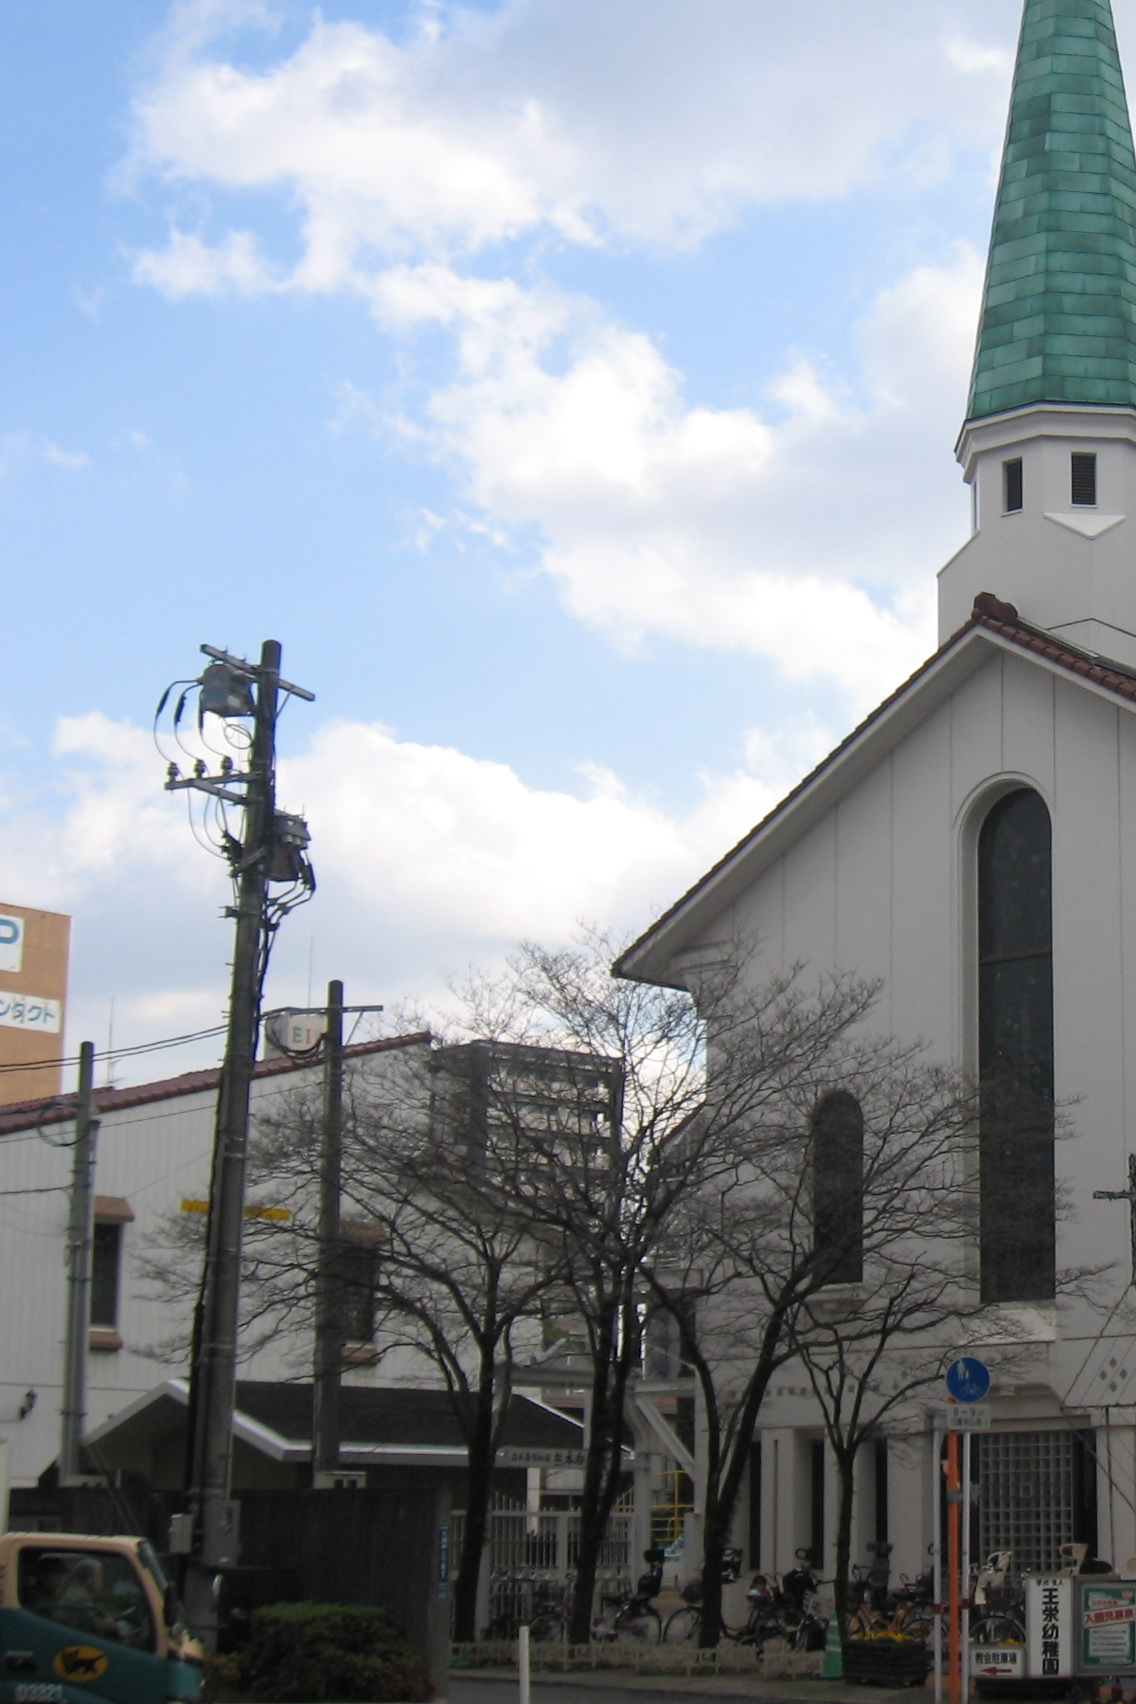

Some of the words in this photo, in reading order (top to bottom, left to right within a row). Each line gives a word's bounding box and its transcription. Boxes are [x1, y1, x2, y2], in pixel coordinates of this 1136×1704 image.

[1041, 1588, 1060, 1676] 王栄幼稚園
